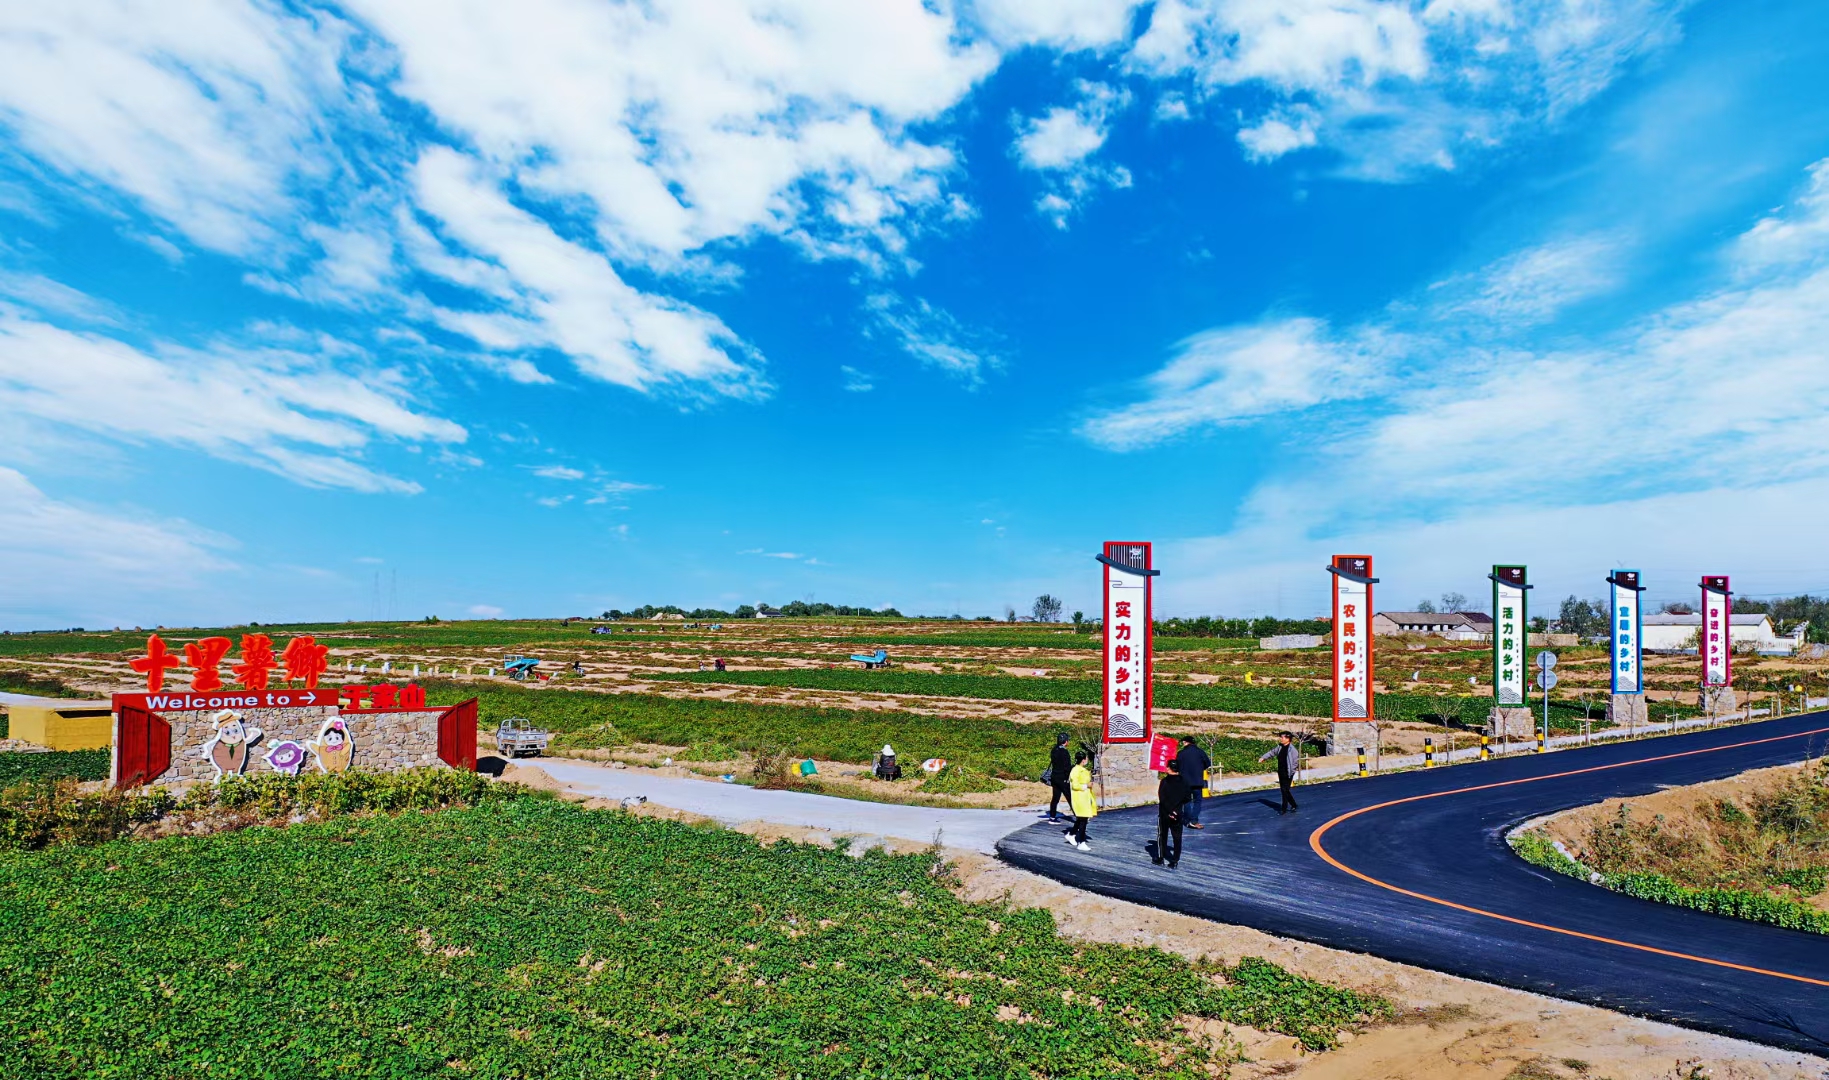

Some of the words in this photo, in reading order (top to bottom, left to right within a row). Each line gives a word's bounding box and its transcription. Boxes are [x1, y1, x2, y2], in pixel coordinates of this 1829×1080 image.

[1114, 601, 1131, 706] 实力的乡村
[1343, 604, 1357, 692] 农民的乡村
[1502, 607, 1513, 681] 活力的乡村
[1619, 606, 1630, 672] 宜居的乡村
[1710, 608, 1719, 666] 奋进的乡村
[145, 695, 258, 709] Welcome
[265, 693, 290, 706] to
[341, 683, 426, 708] 于家山
